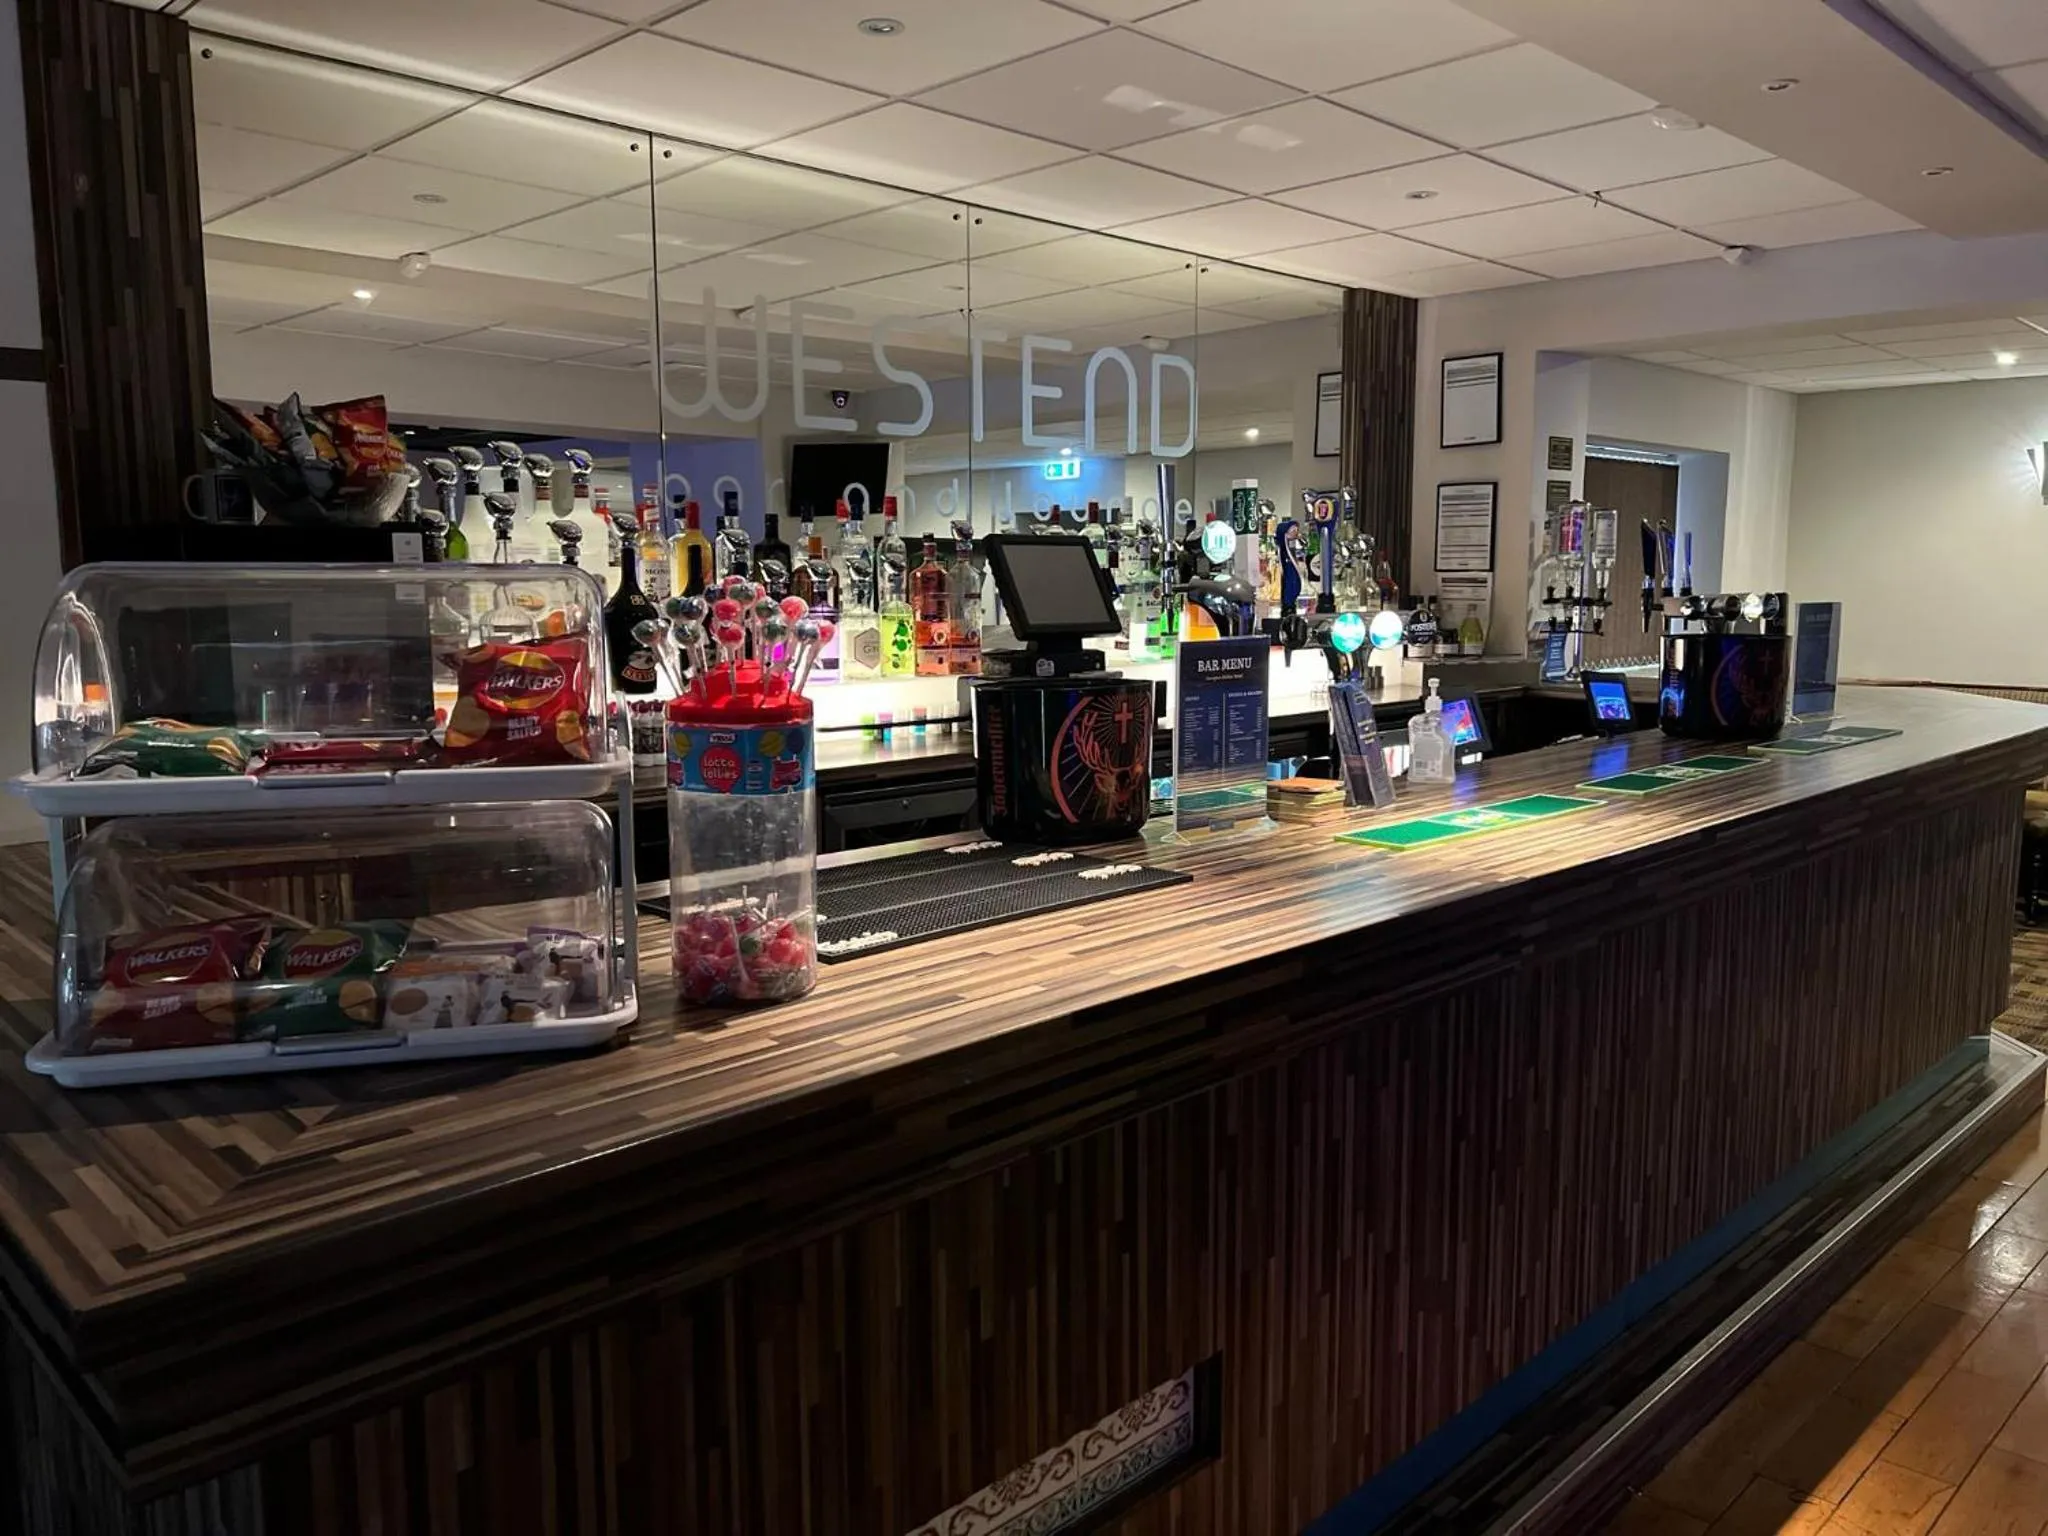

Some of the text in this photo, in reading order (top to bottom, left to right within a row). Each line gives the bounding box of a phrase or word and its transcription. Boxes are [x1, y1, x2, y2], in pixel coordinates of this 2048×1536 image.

[1197, 657, 1253, 673] BAR MENU
[489, 671, 563, 691] WALKERS
[127, 943, 211, 968] WALKERS
[286, 944, 358, 967] WALKERS
